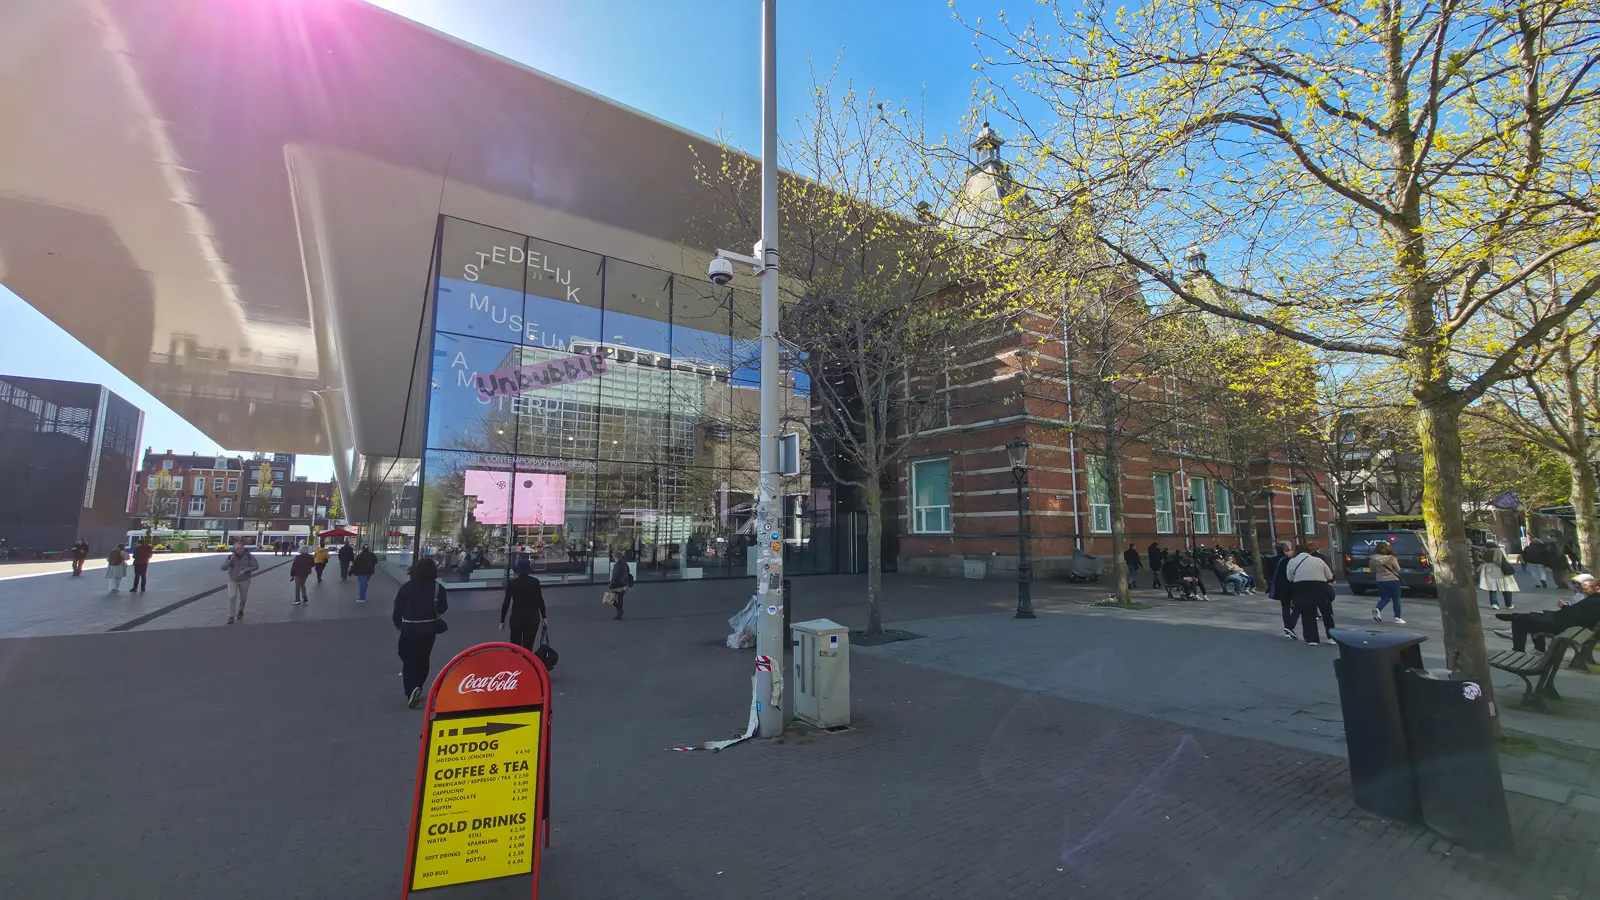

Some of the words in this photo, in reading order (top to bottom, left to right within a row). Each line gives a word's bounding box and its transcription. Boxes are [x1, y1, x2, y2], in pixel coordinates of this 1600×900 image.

[464, 246, 580, 302] STEDELIJK
[469, 293, 573, 354] MUSEUM
[458, 670, 522, 694] Coca-Cola
[437, 740, 499, 756] HOTDOG
[434, 765, 485, 780] COFFEE
[489, 764, 498, 774] &
[504, 760, 529, 772] TEA
[432, 788, 464, 796] CAPPUCINO
[444, 794, 476, 802] CHOCOLATE
[428, 820, 467, 836] COLD
[472, 812, 526, 830] DRINKS
[468, 838, 498, 846] SPARKLING
